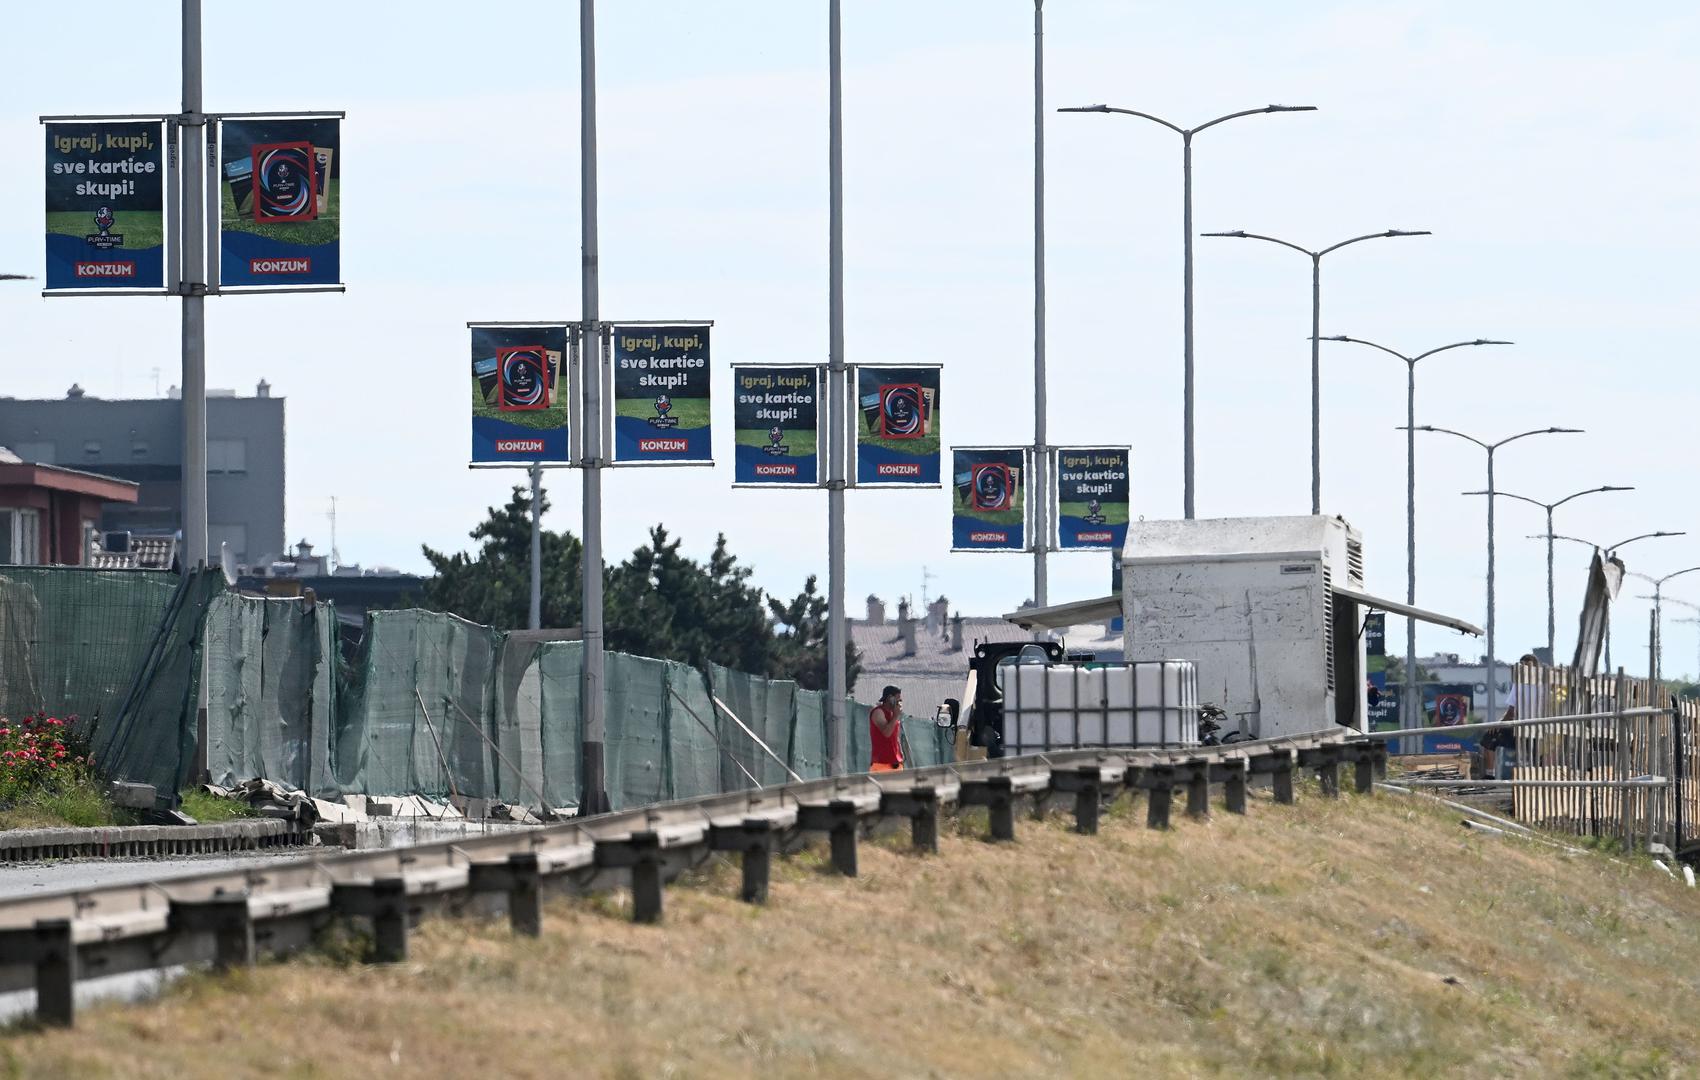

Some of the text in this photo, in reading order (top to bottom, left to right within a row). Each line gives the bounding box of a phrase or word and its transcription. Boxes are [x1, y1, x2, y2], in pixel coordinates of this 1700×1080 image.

[54, 132, 154, 153] Igraj, kupi,
[53, 157, 156, 174] sve kartice
[75, 179, 135, 200] skupi!
[77, 264, 132, 276] KONZUM
[252, 260, 308, 273] KONZUM
[621, 334, 703, 351] Igraj, kupi,
[620, 354, 705, 369] sve kartice
[639, 372, 688, 390] skupi!
[740, 374, 811, 390] Igraj, kupi,
[739, 394, 764, 404] sve
[765, 391, 812, 404] kartice
[756, 407, 798, 422] skupi!
[497, 441, 542, 451] KONZUM
[641, 441, 686, 450] KONZUM
[1063, 455, 1124, 468] Igraj, kupi,
[756, 465, 795, 474] KONZUM
[880, 465, 918, 474] KONZUM
[1062, 469, 1125, 481] sve kartice
[1076, 482, 1113, 496] skupi!
[971, 533, 1006, 542] KONZUM
[1078, 533, 1112, 541] KONZUM
